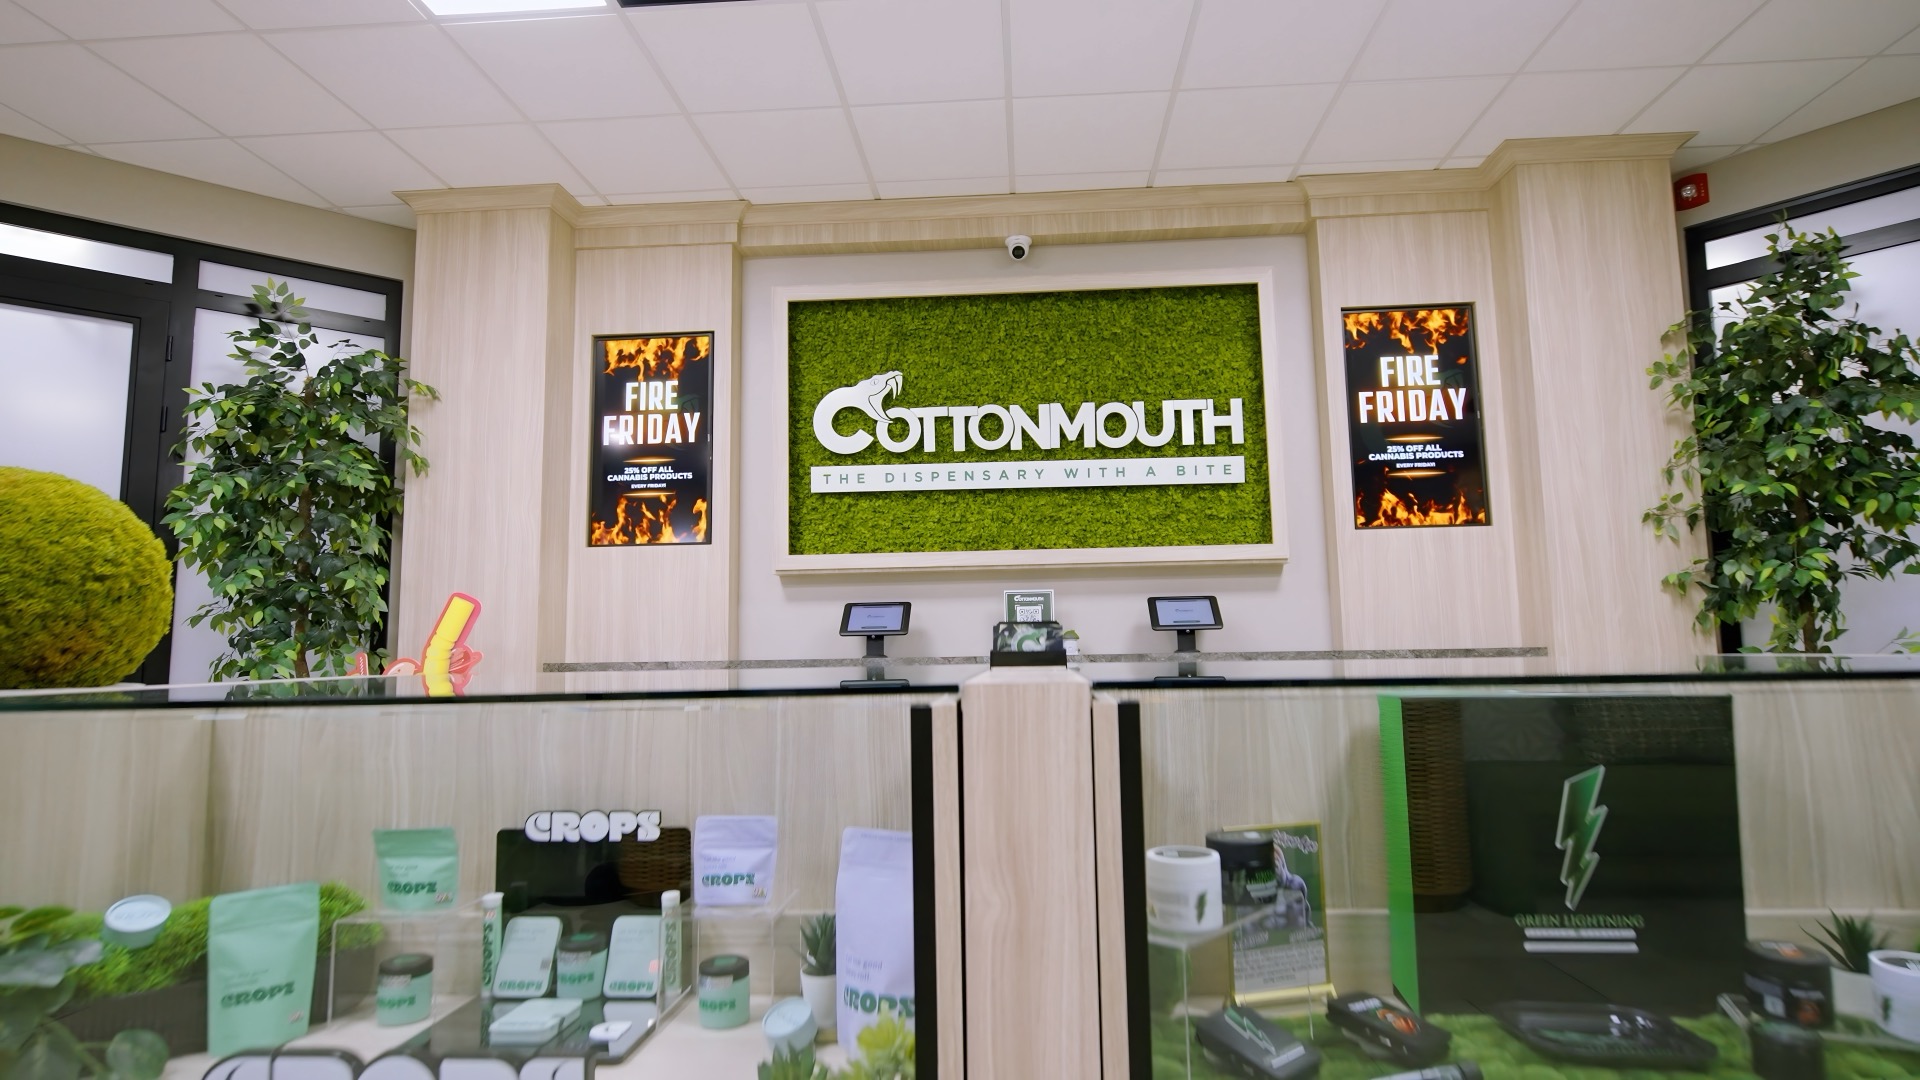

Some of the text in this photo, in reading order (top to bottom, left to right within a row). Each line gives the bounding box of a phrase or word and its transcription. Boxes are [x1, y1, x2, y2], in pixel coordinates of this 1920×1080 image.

[1380, 354, 1441, 388] FIRE
[625, 380, 679, 411] FIRE
[1358, 387, 1467, 424] FRIDAY
[813, 371, 1244, 454] COTTONMOUTH
[602, 412, 700, 446] FRIDAY
[1368, 451, 1464, 461] CANNABIS PRODUCTS
[1387, 445, 1404, 453] 25%
[1406, 444, 1424, 452] OFF
[649, 472, 693, 480] PRODUCTS
[823, 464, 1233, 486] THE DISPENSARY WITH A BITE
[524, 810, 661, 843] CROPS
[1515, 913, 1645, 929] GREEN LIGHTNING
